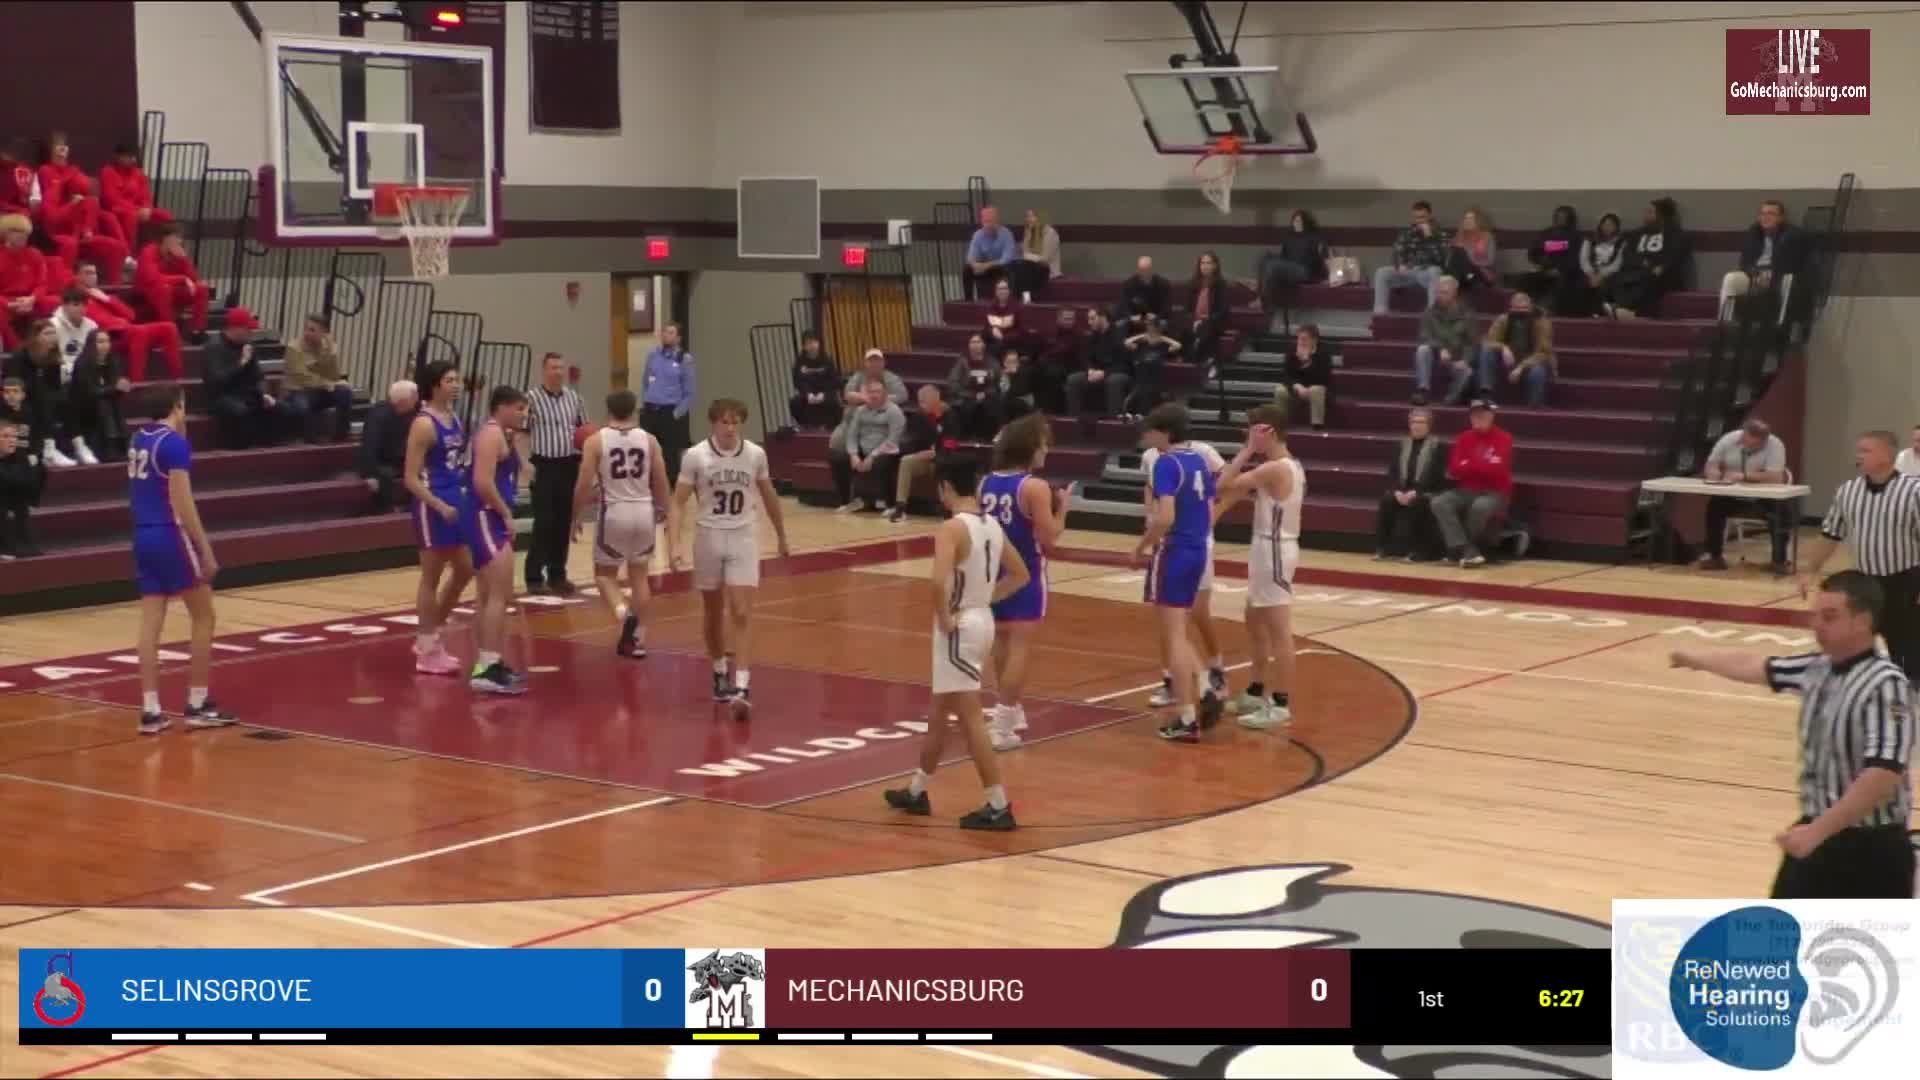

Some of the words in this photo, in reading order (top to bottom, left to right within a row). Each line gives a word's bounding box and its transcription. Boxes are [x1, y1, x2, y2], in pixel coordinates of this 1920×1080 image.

[609, 447, 645, 480] 23
[1193, 470, 1205, 501] 4
[713, 490, 744, 515] 30
[982, 492, 1013, 525] 23
[984, 539, 992, 584] 1
